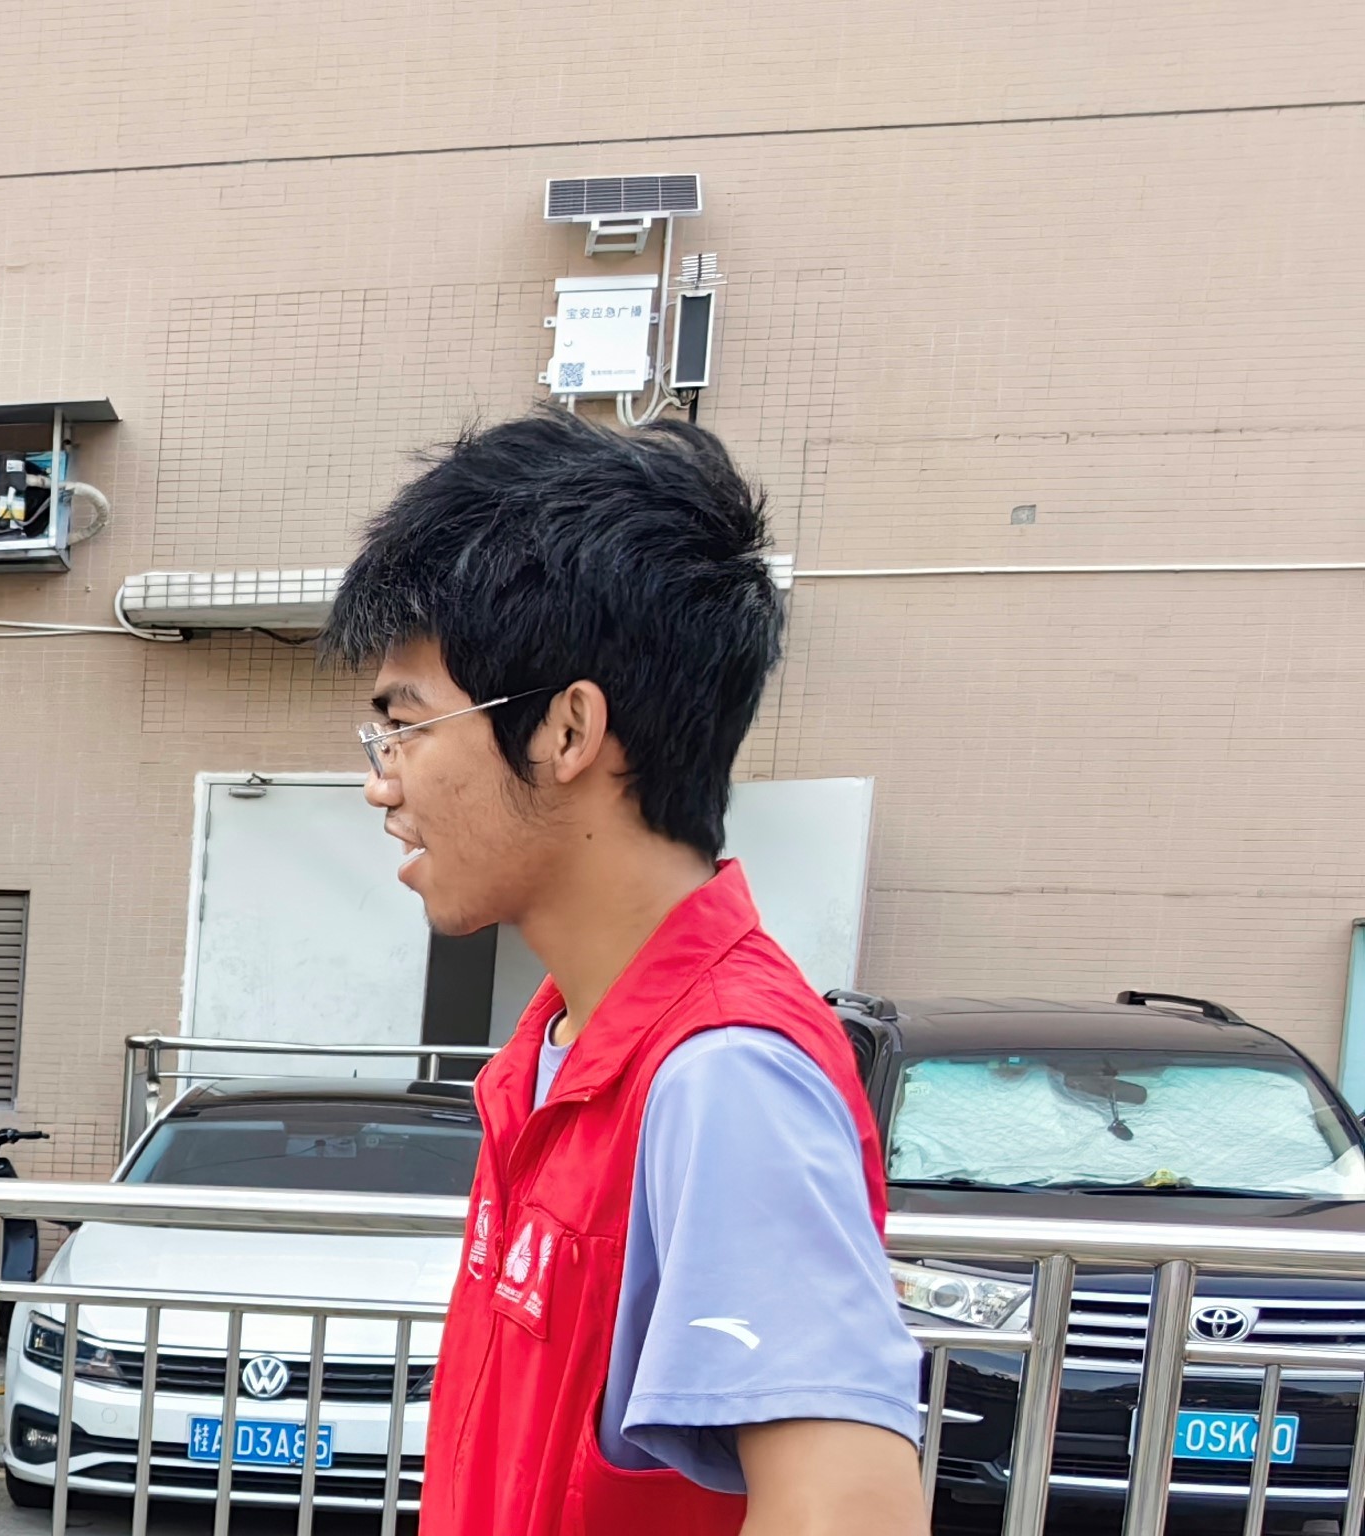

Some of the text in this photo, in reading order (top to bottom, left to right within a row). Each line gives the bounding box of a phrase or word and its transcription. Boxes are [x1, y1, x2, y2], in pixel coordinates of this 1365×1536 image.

[566, 305, 642, 320] 宝安应急广播
